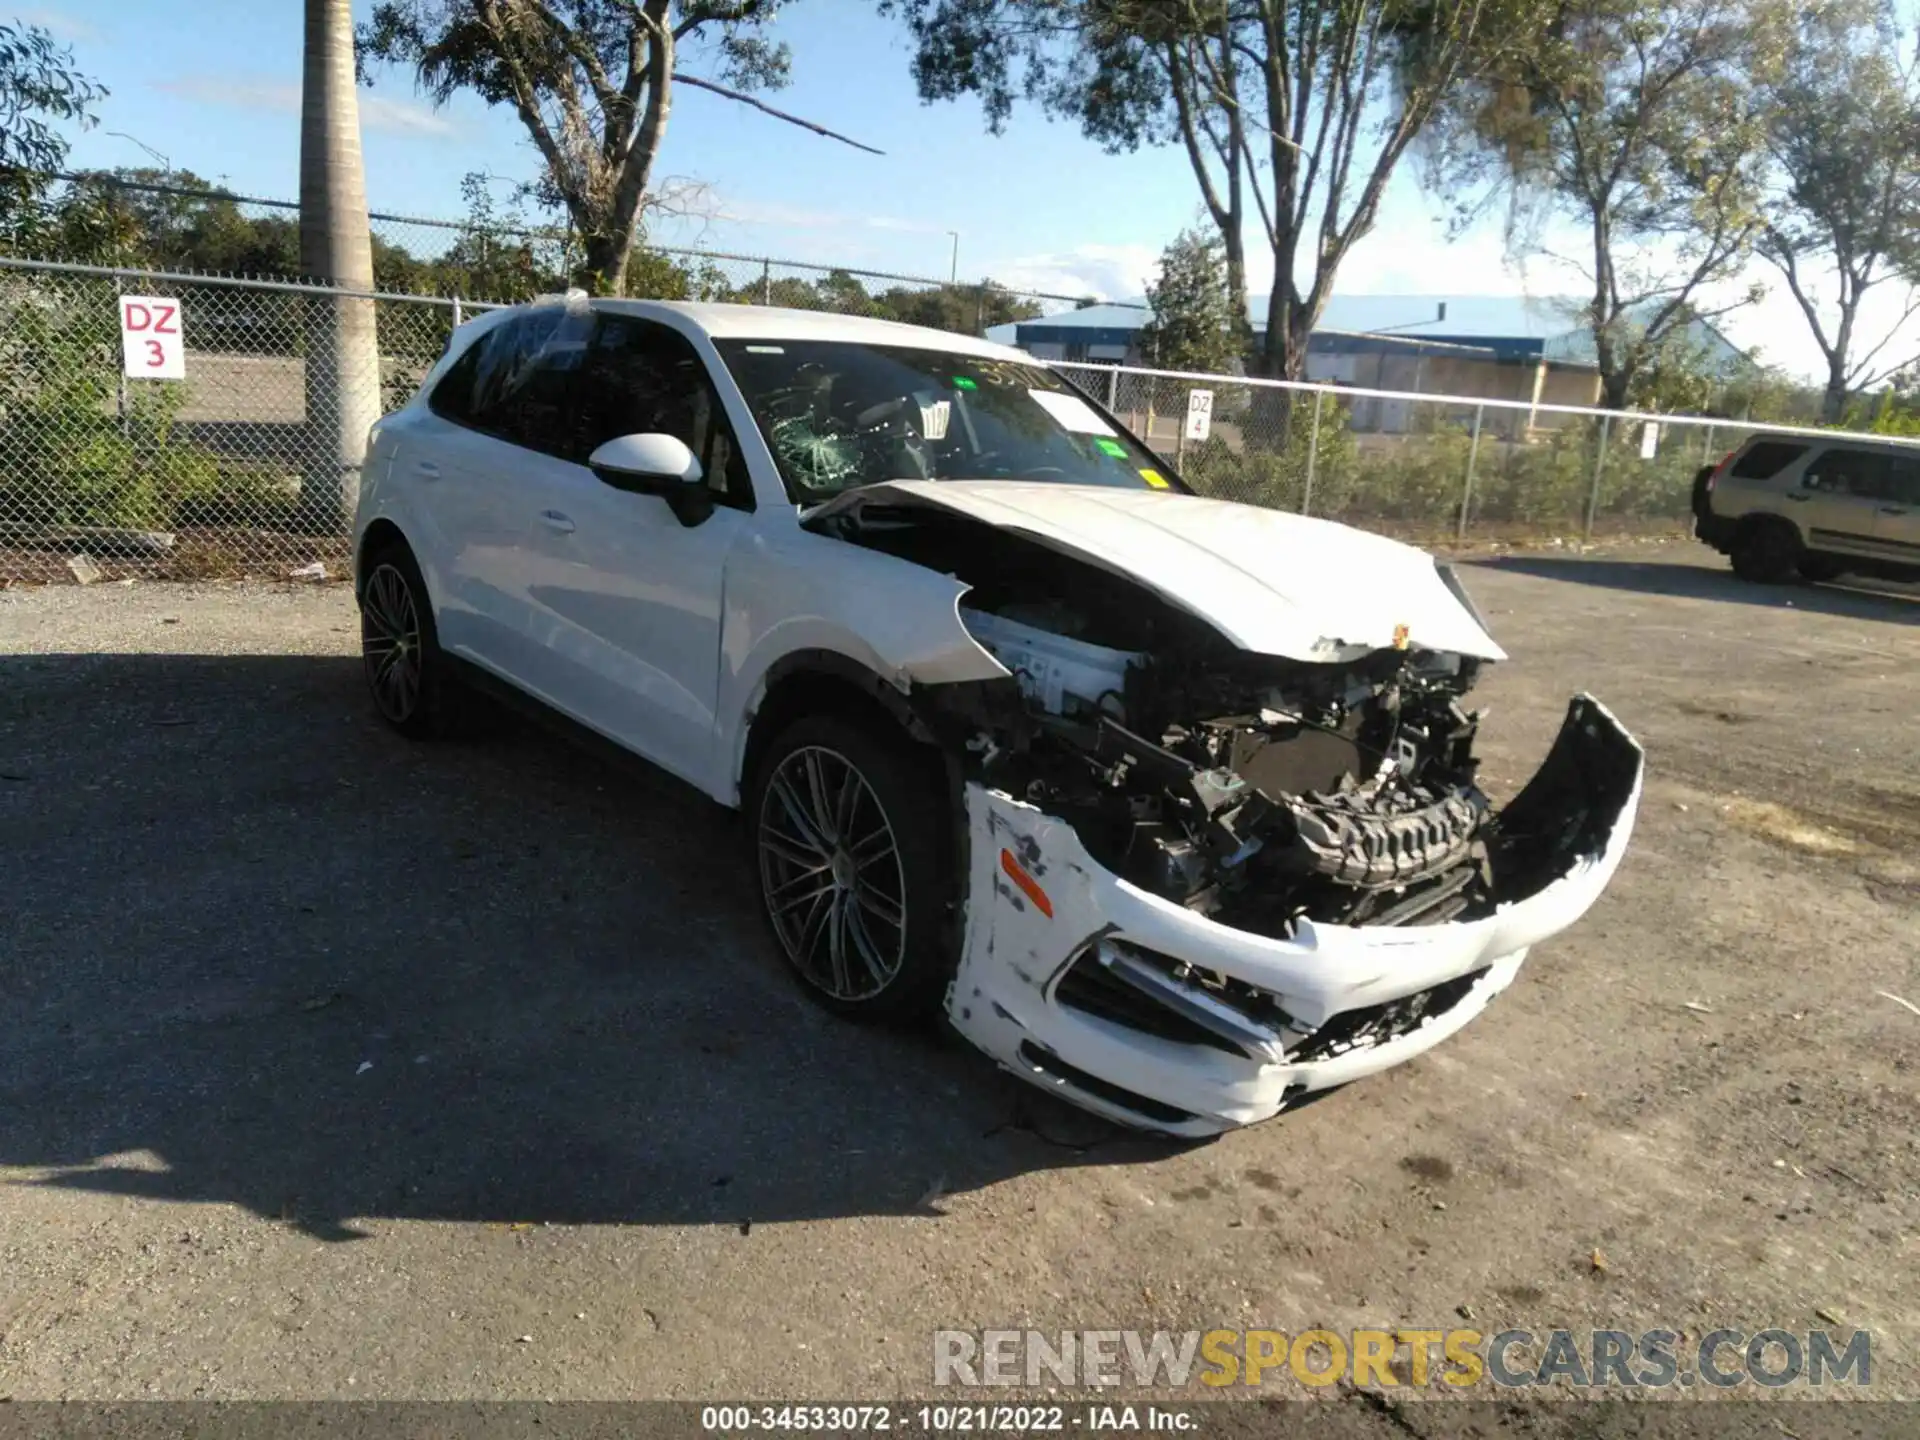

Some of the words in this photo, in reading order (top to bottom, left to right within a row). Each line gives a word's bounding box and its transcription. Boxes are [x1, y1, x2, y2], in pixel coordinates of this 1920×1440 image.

[125, 303, 178, 334] DZ
[144, 340, 165, 367] 3
[1190, 395, 1210, 413] DZ
